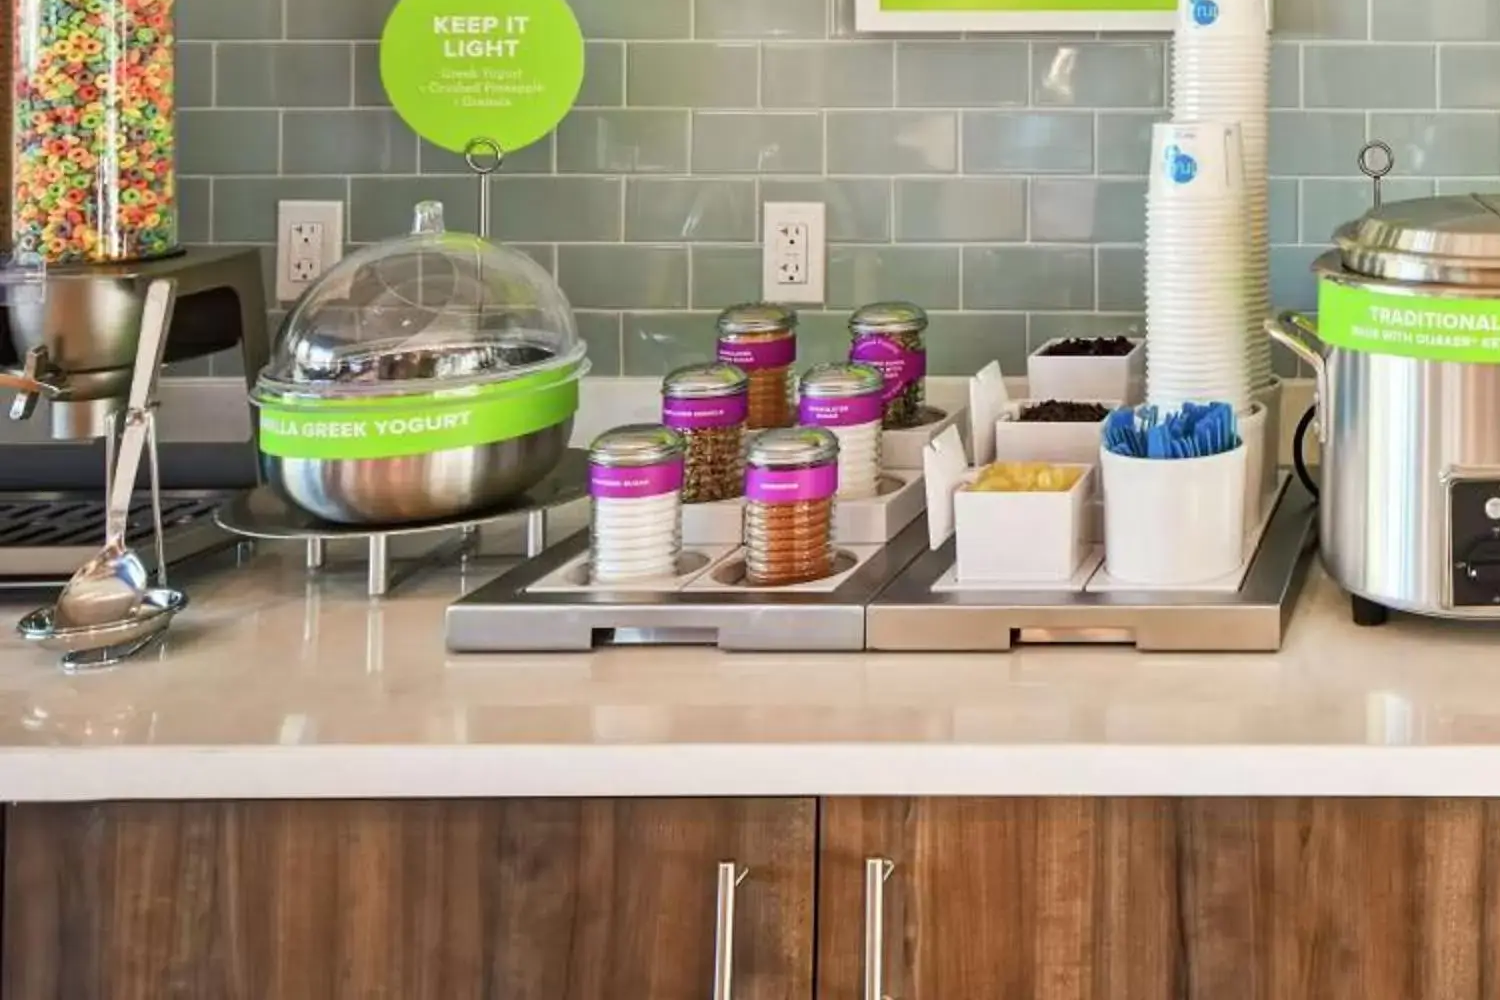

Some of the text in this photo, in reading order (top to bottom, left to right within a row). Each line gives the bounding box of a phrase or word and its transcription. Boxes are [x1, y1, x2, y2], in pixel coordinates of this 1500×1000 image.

[433, 15, 529, 35] KEEP IT
[444, 40, 519, 58] LIGHT
[301, 421, 366, 438] GREEK
[373, 410, 473, 435] YOGURT
